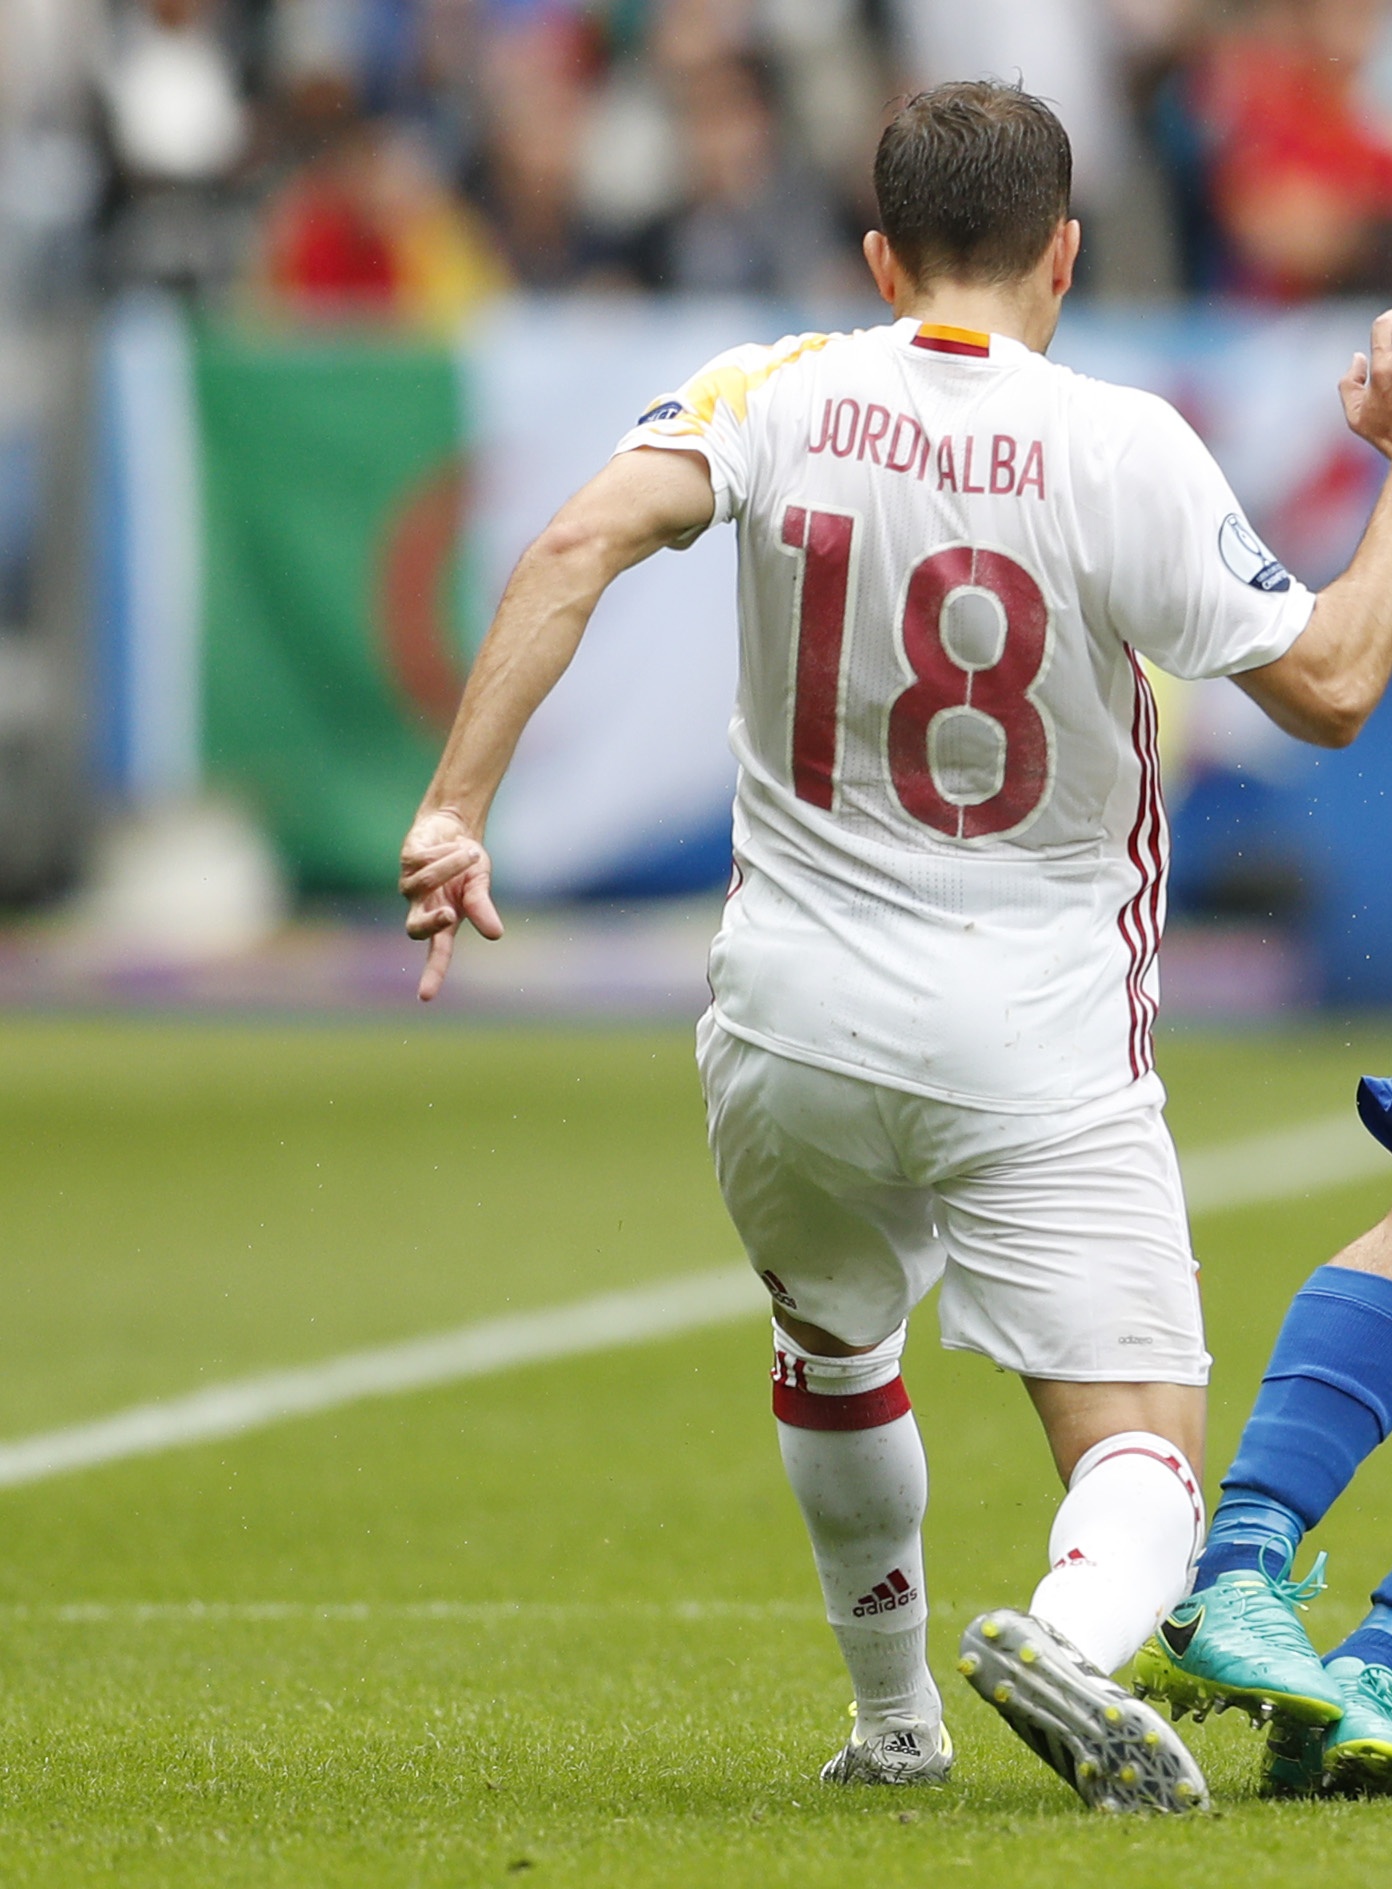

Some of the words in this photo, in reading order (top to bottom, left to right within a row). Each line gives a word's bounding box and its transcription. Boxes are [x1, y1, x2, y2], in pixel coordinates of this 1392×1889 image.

[808, 398, 931, 481] JORDI
[936, 434, 1046, 501] ALBA
[775, 499, 1057, 844] 18
[852, 1587, 918, 1618] adidas
[884, 1744, 921, 1758] adidas
